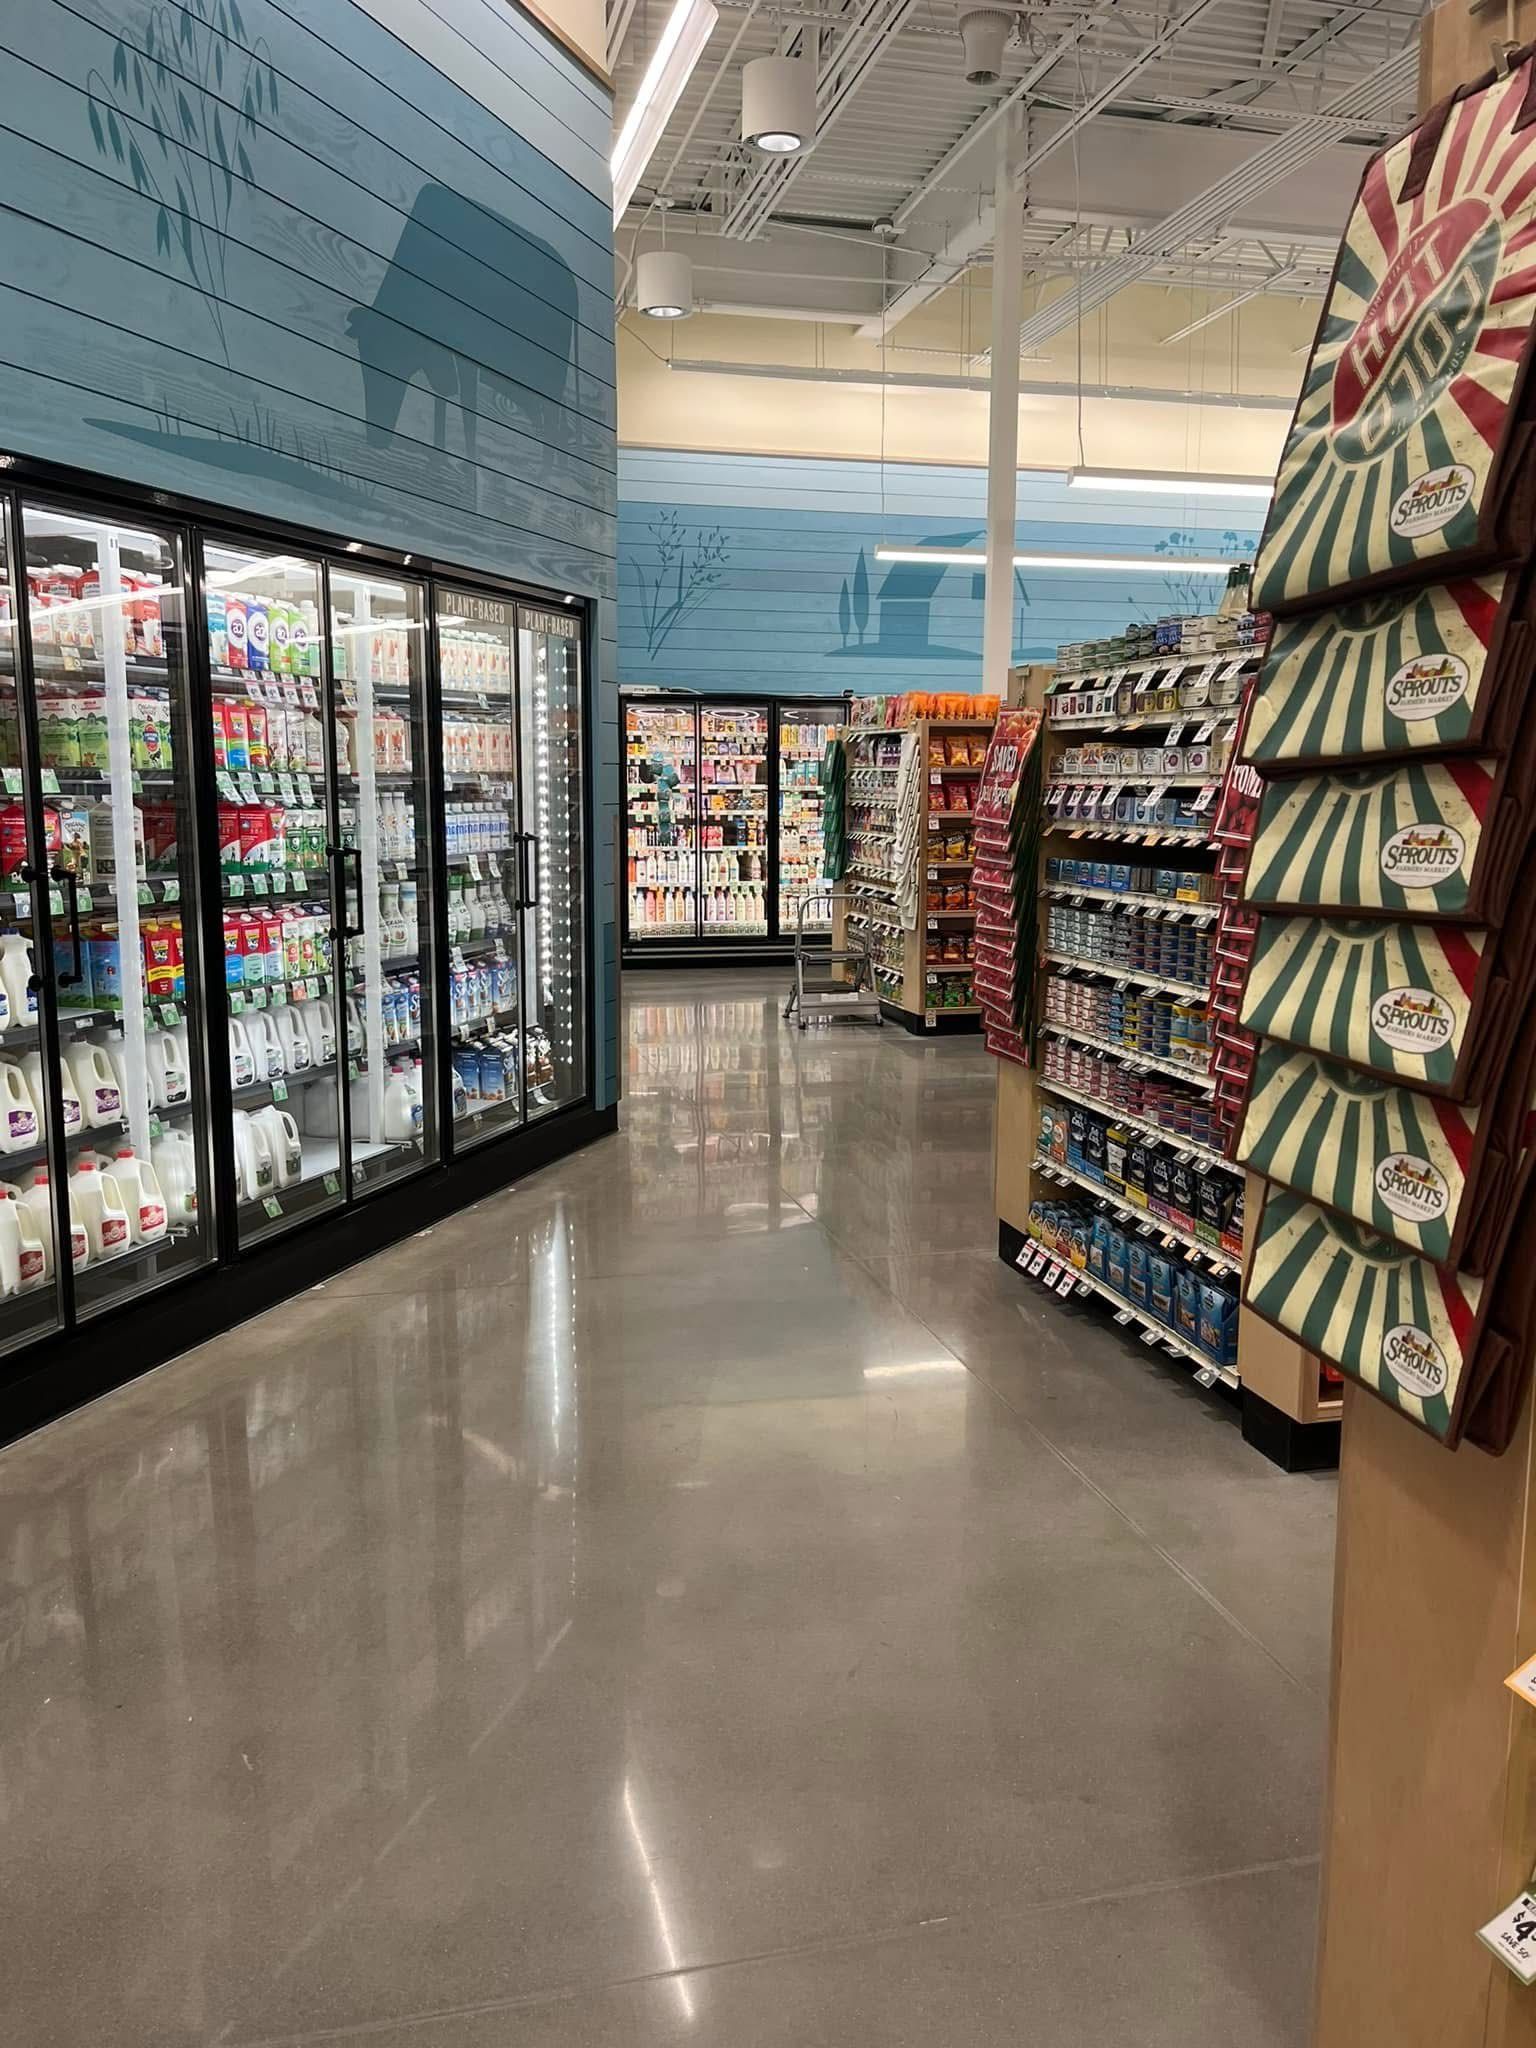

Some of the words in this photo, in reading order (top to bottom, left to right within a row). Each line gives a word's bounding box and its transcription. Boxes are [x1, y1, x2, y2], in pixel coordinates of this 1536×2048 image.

[1352, 228, 1444, 387] HOT
[1360, 263, 1485, 455] COLD
[1394, 482, 1468, 526] SPROUTS
[446, 593, 505, 625] PLANT-BASED
[525, 610, 574, 638] PLANT-BASED
[1389, 675, 1463, 706] SPROUTS
[1384, 845, 1458, 869] SPROUTS
[1375, 1004, 1450, 1036] SPROUTS
[1378, 1167, 1443, 1208] SPROUTS
[1386, 1337, 1442, 1385] SPROUTS
[1501, 1932, 1520, 1949] SAVE
[1512, 1911, 1536, 1942] $4
